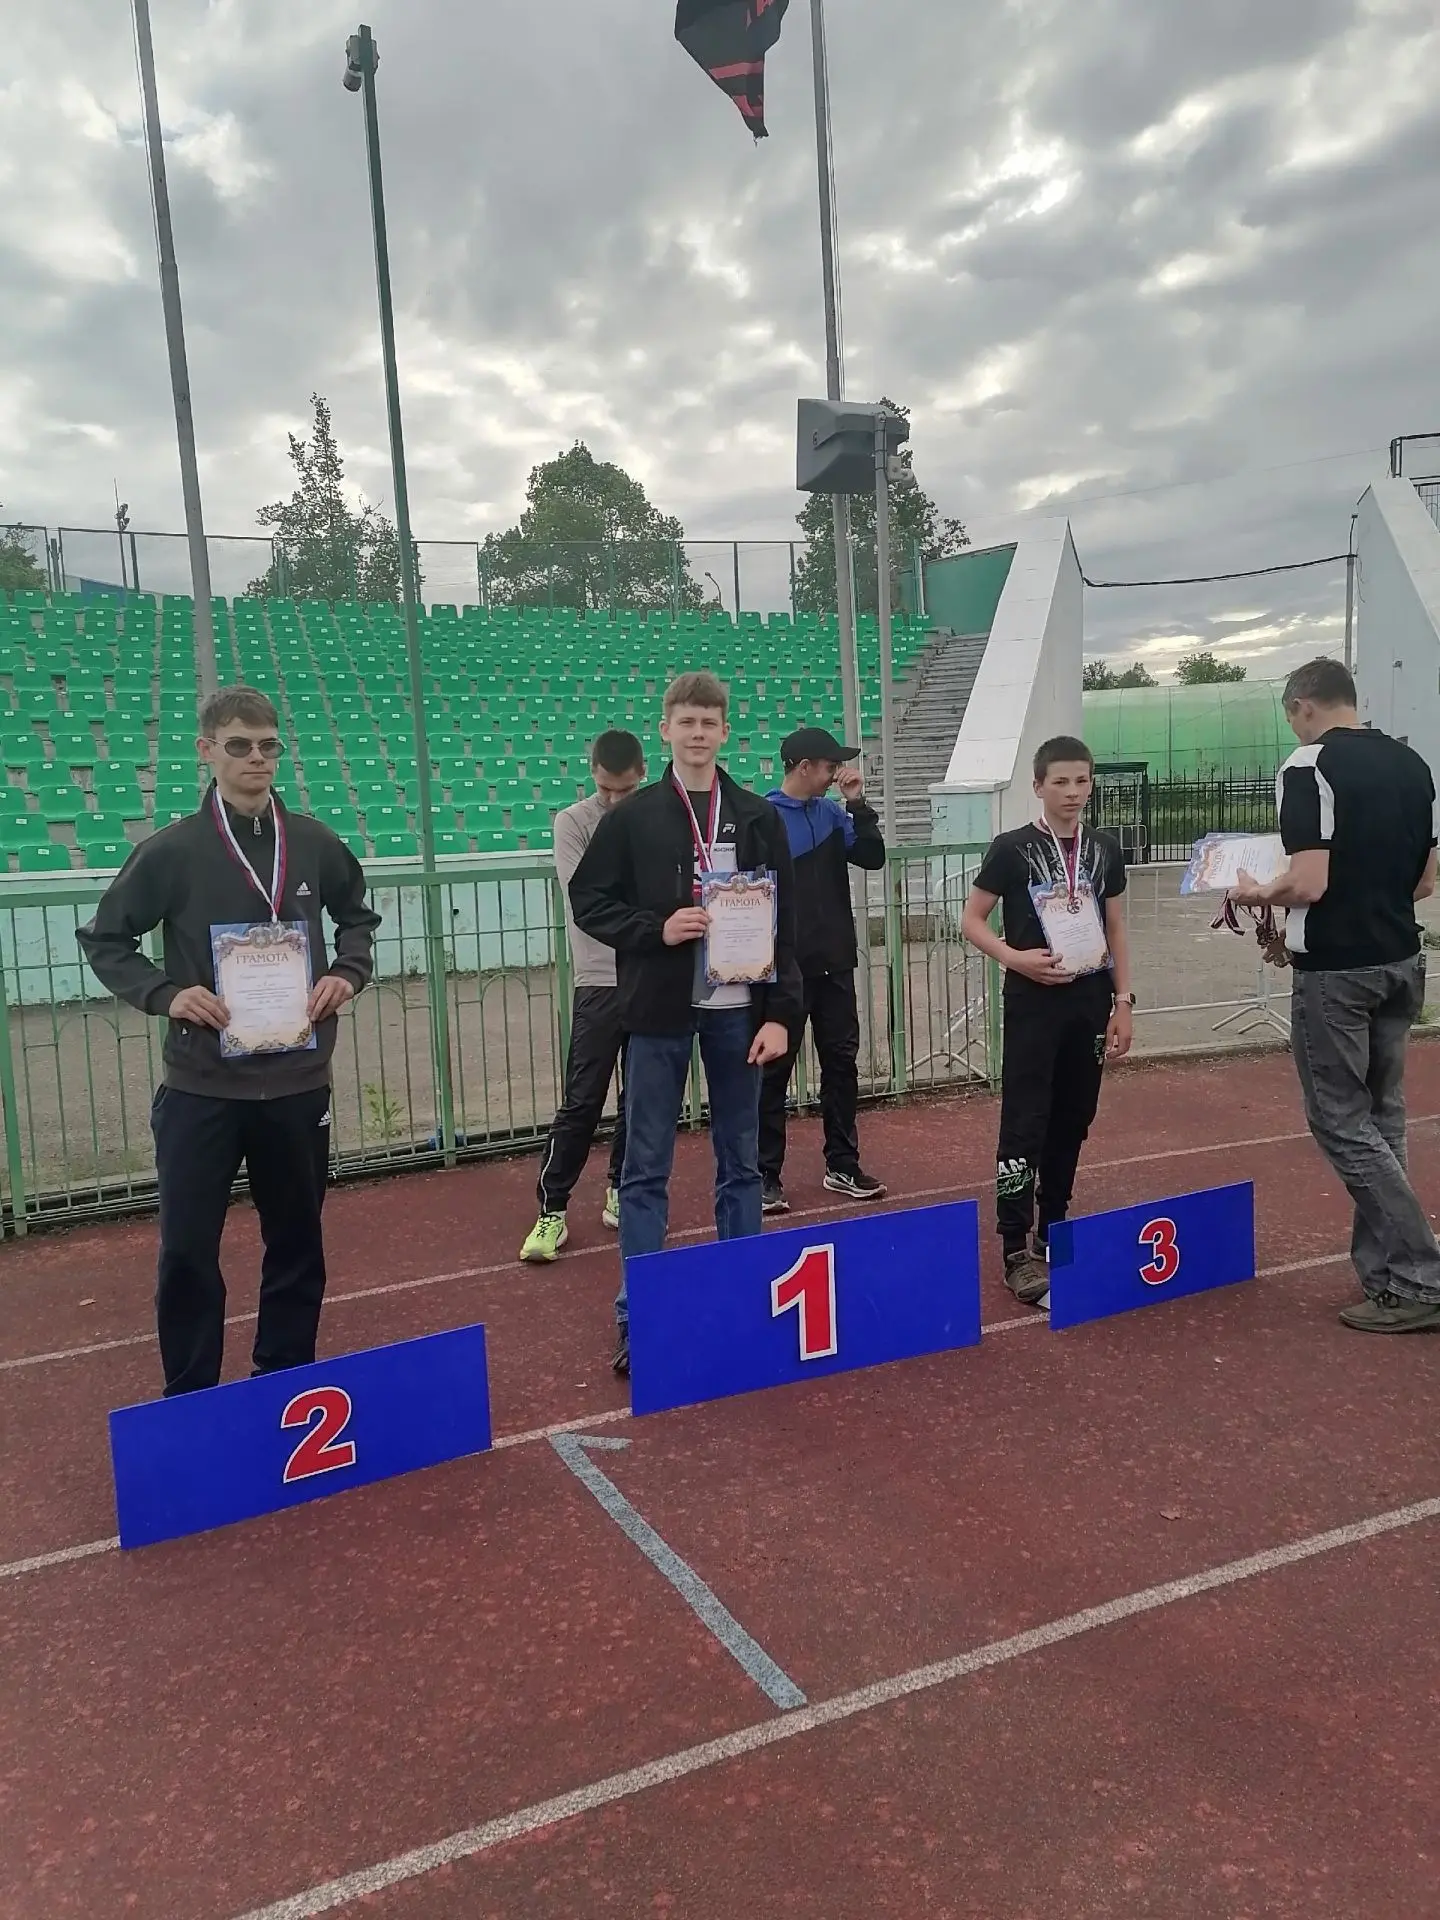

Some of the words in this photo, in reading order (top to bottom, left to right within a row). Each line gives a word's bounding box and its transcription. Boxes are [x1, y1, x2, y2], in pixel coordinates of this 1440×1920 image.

[720, 898, 761, 908] ГРАМОТА
[236, 952, 289, 964] ГРАМОТА
[1138, 1217, 1180, 1285] 3
[771, 1243, 838, 1361] 1
[281, 1386, 356, 1483] 2
